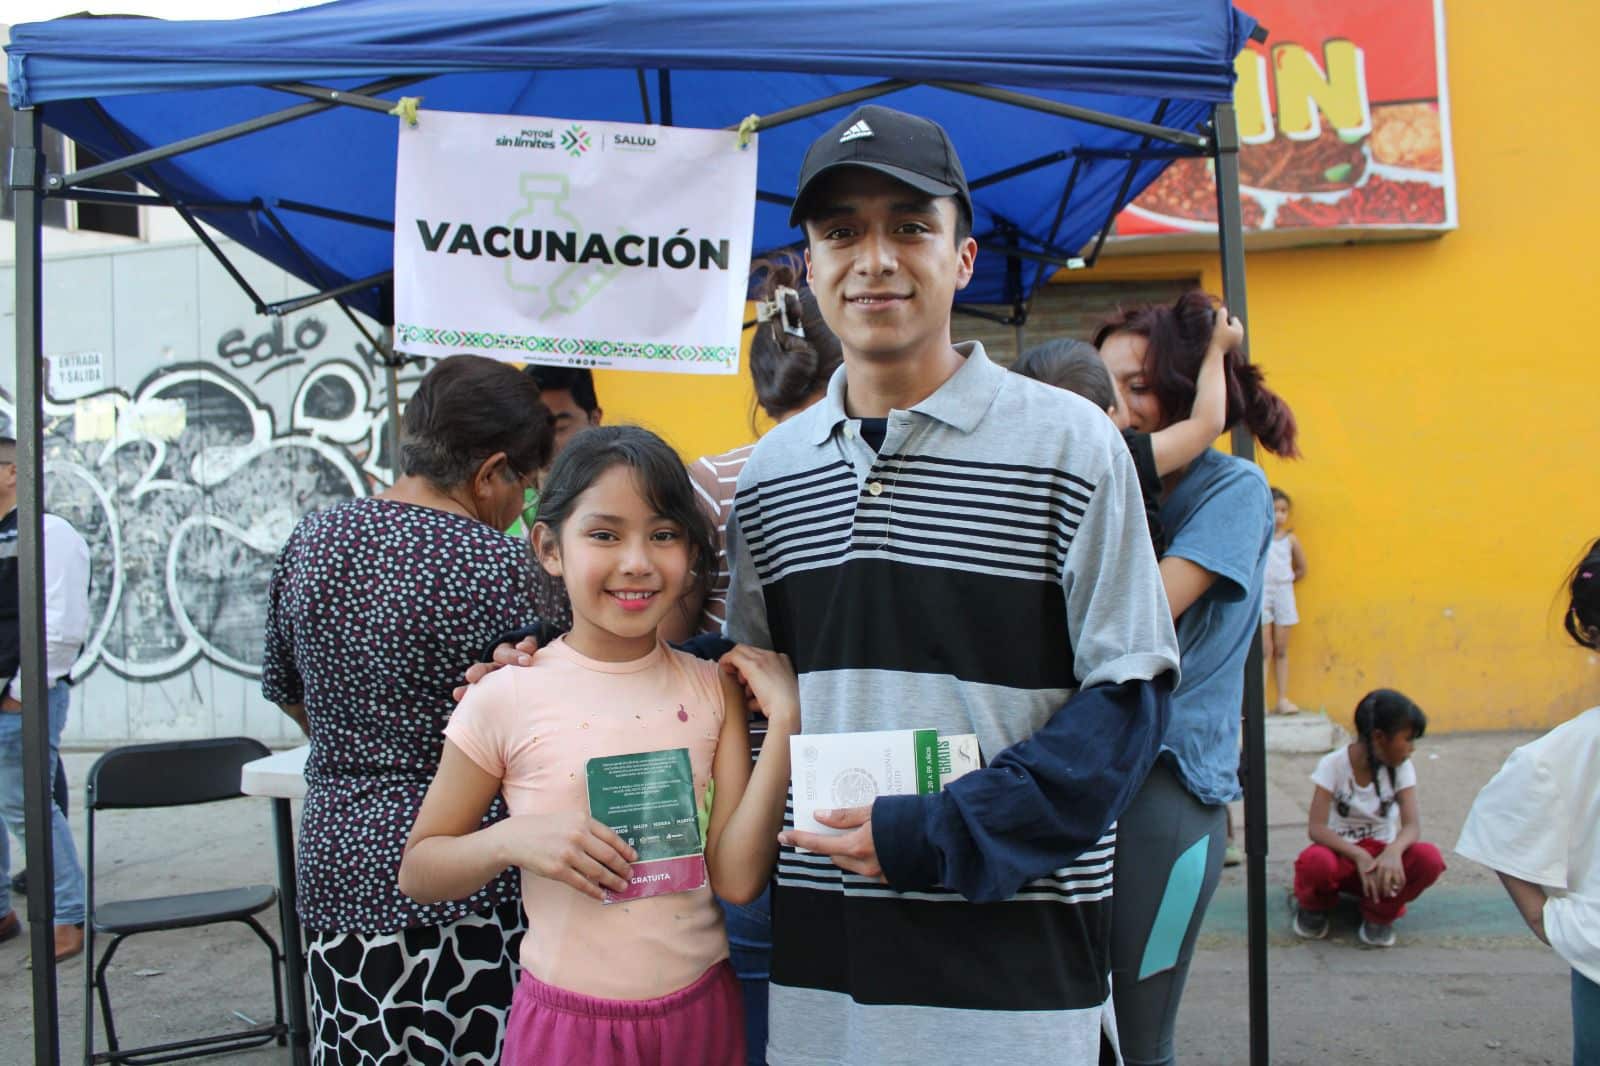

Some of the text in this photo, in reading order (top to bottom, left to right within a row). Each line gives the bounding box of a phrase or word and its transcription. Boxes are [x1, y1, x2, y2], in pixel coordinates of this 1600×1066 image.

[496, 136, 513, 147] sin
[614, 134, 657, 146] SALUD
[416, 219, 730, 270] VACUNACIÓN
[58, 354, 100, 368] ENTRADA
[937, 740, 951, 774] GRATIS
[631, 873, 672, 884] GRATUITA
